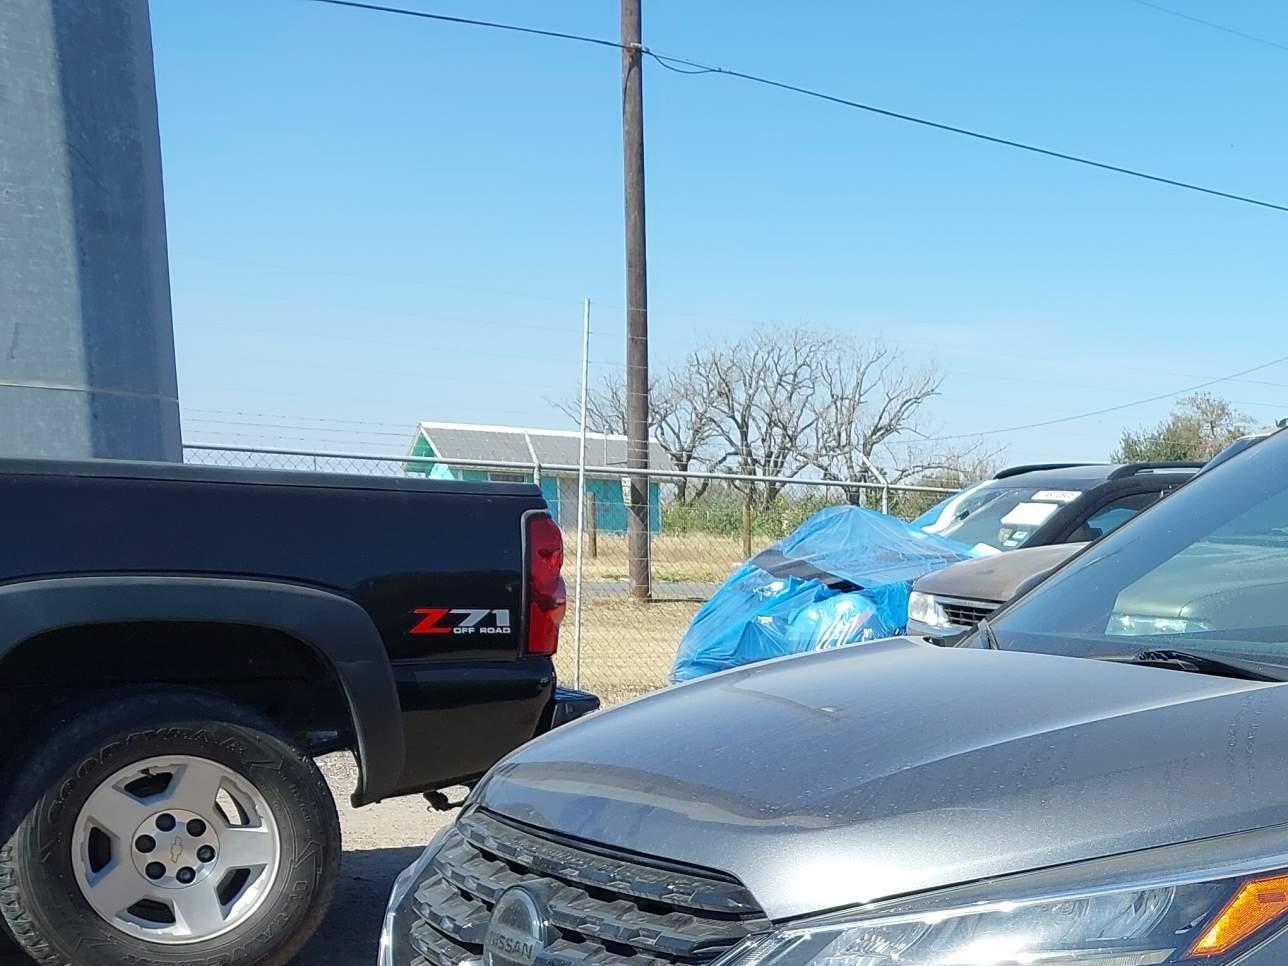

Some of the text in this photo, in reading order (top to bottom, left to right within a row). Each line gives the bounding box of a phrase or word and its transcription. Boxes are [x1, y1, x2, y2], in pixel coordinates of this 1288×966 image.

[410, 608, 510, 634] Z71
[453, 627, 511, 635] OFF ROAD
[490, 931, 534, 960] NISSAN
